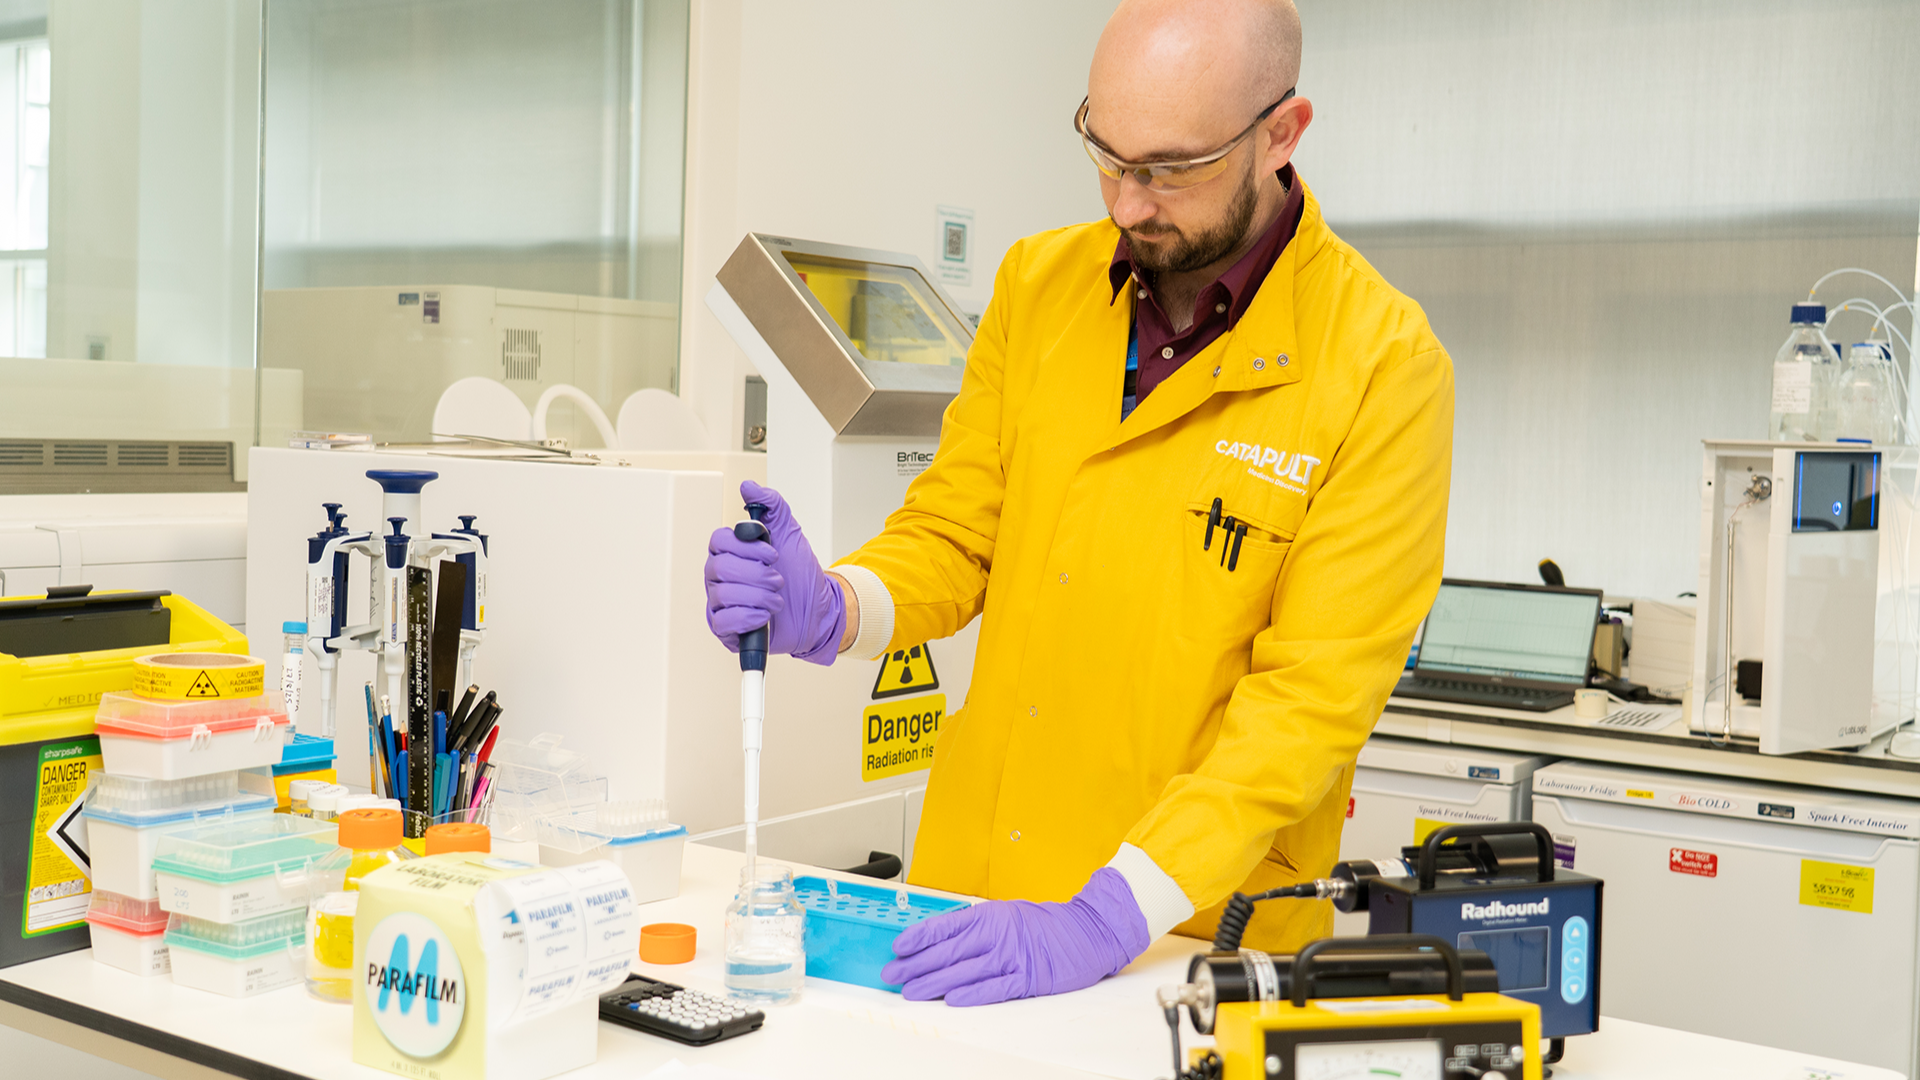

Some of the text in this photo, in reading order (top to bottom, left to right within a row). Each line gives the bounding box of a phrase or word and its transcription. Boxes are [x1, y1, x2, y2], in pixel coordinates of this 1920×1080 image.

[897, 452, 934, 462] BriTec
[1215, 440, 1321, 485] CATAPULT
[1275, 478, 1308, 496] Discovery
[230, 676, 264, 687] RADIOACTIVE
[236, 670, 259, 679] CAUTION
[234, 684, 261, 693] MATERIAL
[868, 709, 942, 744] Danger
[44, 746, 83, 759] sharpsafe
[867, 743, 935, 771] Radiation ris
[43, 761, 87, 785] DANGER
[41, 782, 77, 797] CONTAMINATED
[1539, 778, 1618, 797] Laboratory Fridge
[40, 793, 73, 808] SHARPS ONLY
[1417, 804, 1499, 822] Spark Free Interior
[1807, 810, 1838, 823] Spark
[1841, 814, 1865, 826] Free
[1866, 817, 1908, 831] Interior
[1702, 862, 1714, 871] off
[174, 887, 189, 898] 200
[409, 877, 447, 890] FILM
[586, 887, 630, 907] PARAFILM
[528, 902, 574, 922] PARAFILM
[1461, 897, 1549, 920] Radhound
[368, 963, 456, 1004] PARAFILM
